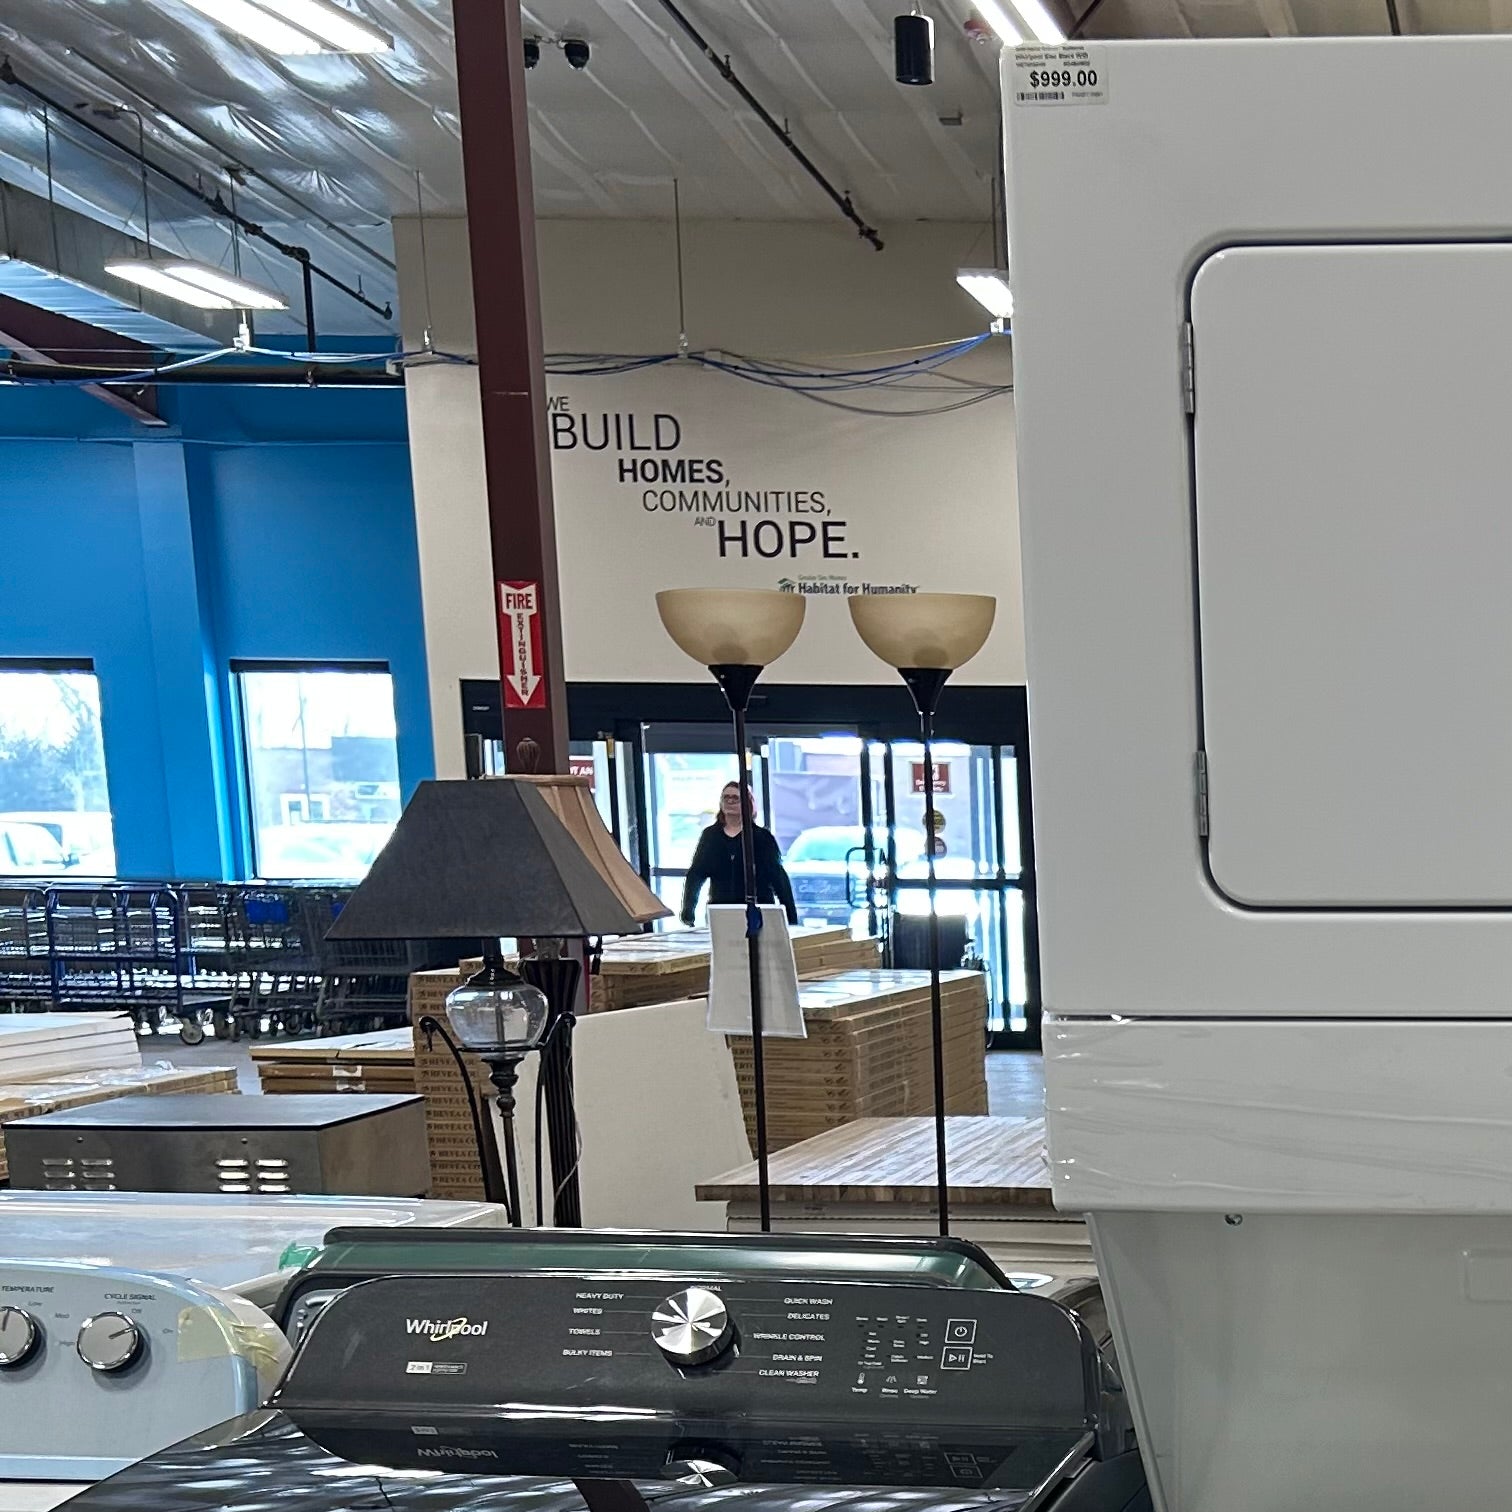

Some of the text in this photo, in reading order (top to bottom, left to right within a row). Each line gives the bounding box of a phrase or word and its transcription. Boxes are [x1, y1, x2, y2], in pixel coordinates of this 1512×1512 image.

[1029, 70, 1097, 88] $999.00
[552, 412, 681, 451] BUILD
[618, 458, 731, 488] HOMES,
[642, 489, 833, 516] COMMUNITIES,
[717, 519, 860, 559] HOPE.
[798, 582, 840, 595] Habitat
[843, 582, 860, 595] for
[506, 593, 533, 609] FIRE
[517, 613, 529, 696] EXTINGUISHER
[2, 1285, 54, 1293] TEMPERATURE
[129, 1293, 156, 1301] SIGNAL
[406, 1317, 488, 1341] Whirlpool
[753, 1332, 826, 1341] WRINKLE CONTROL
